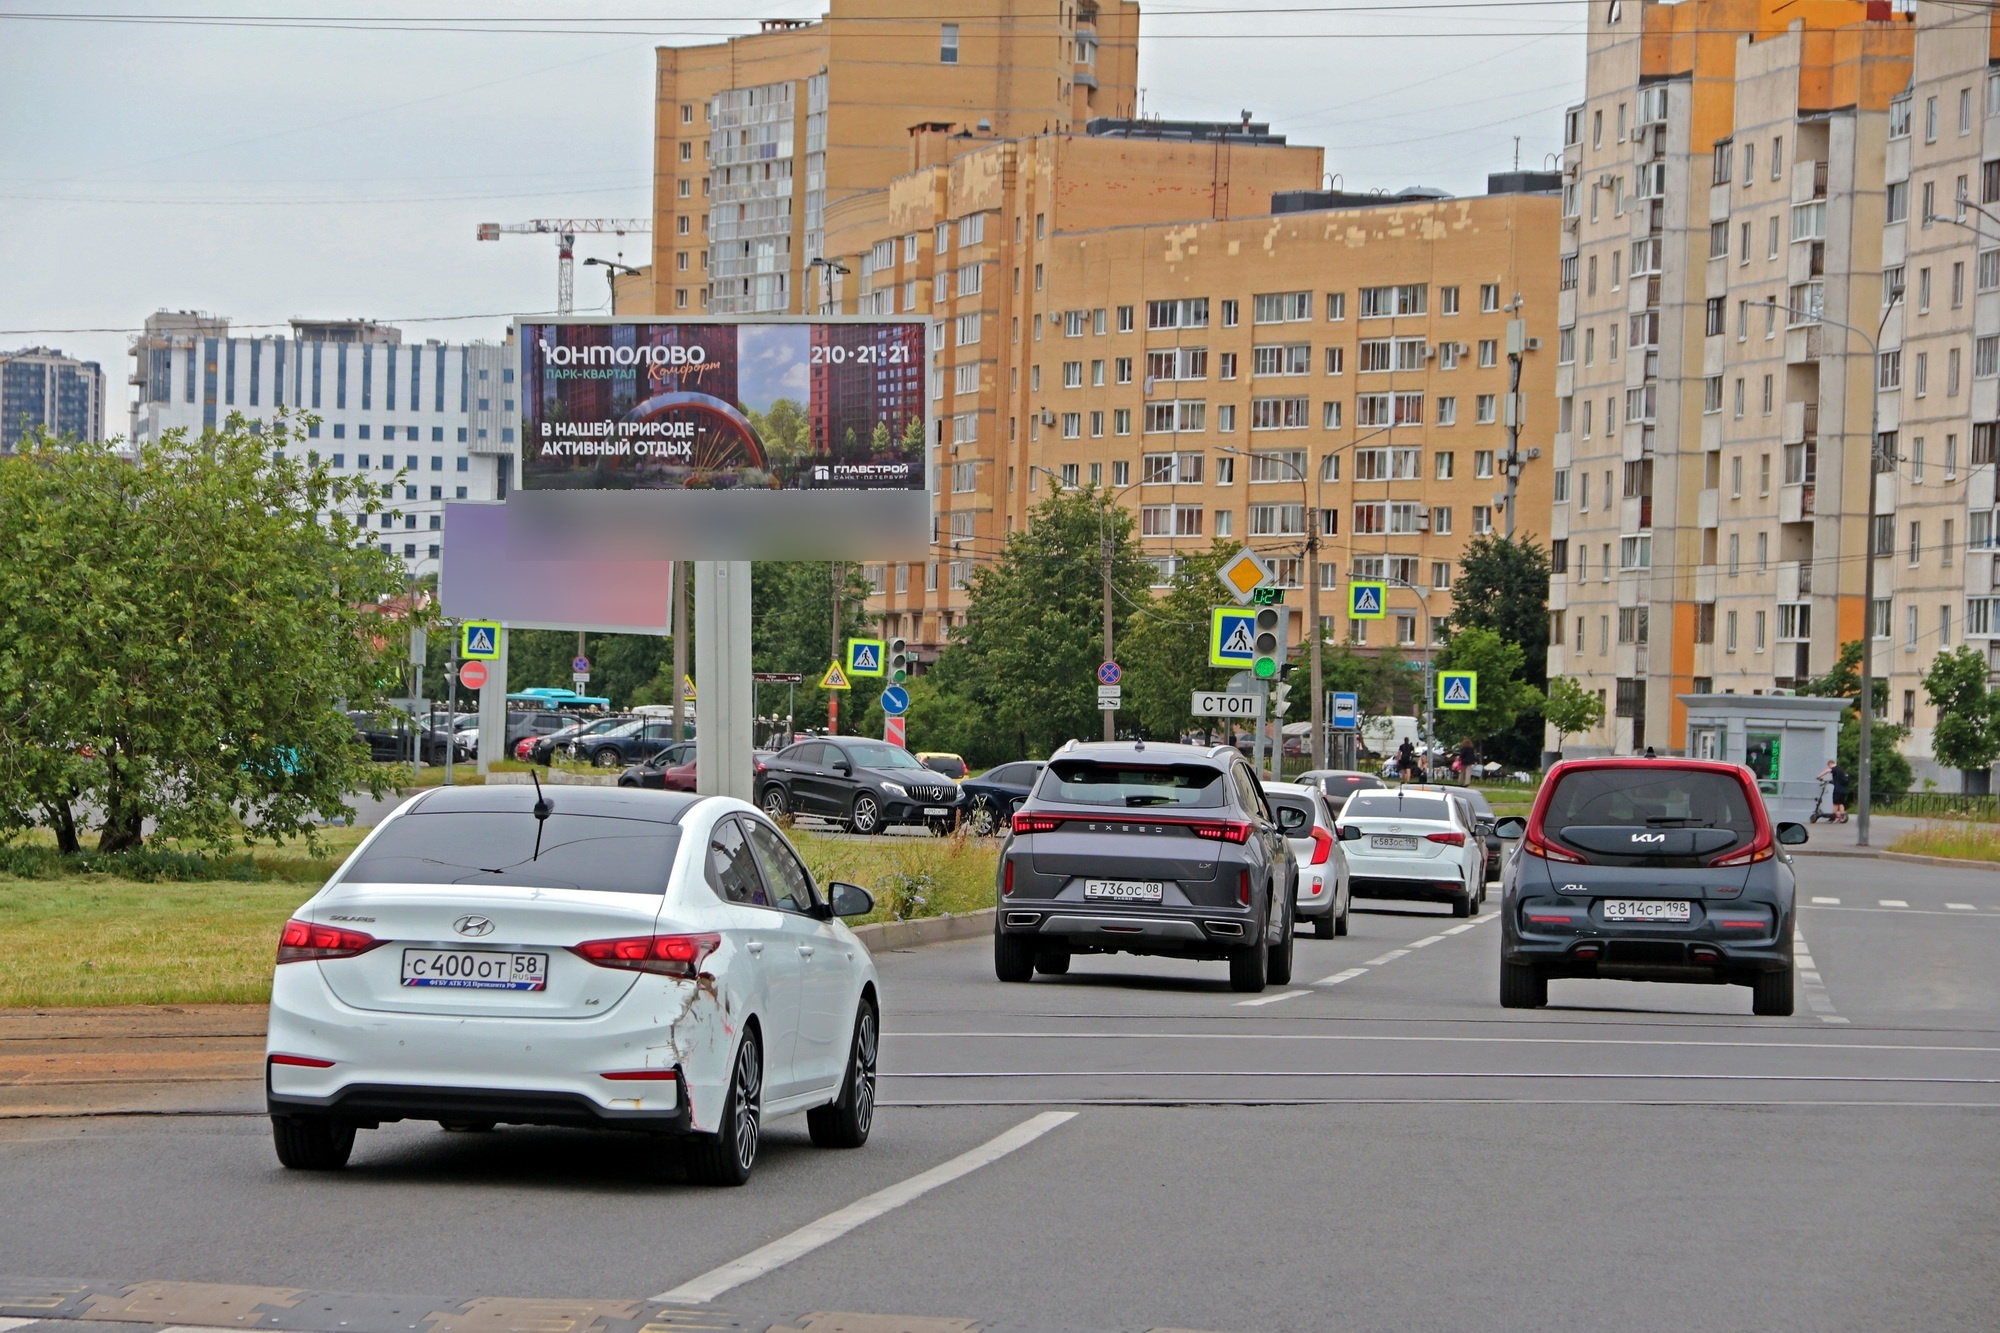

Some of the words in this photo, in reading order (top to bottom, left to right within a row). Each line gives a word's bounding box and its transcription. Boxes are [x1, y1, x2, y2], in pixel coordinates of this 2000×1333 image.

[546, 369, 636, 379] ПАРК-КВАРТАЛ
[646, 360, 720, 385] Комфорт
[541, 422, 552, 437] В
[555, 419, 614, 437] НАШЕЙ
[618, 422, 695, 438] ПРИРОДЕ
[541, 440, 631, 456] АКТИВНЫЙ
[634, 441, 692, 457] ОТДЫХ
[833, 463, 909, 474] ГЛАВСТРОЙ
[1203, 696, 1253, 713] СТОП
[1088, 824, 1163, 833] EXEED
[1631, 833, 1666, 843] KIA
[329, 914, 377, 922] SOLARIS
[512, 973, 530, 981] RUS
